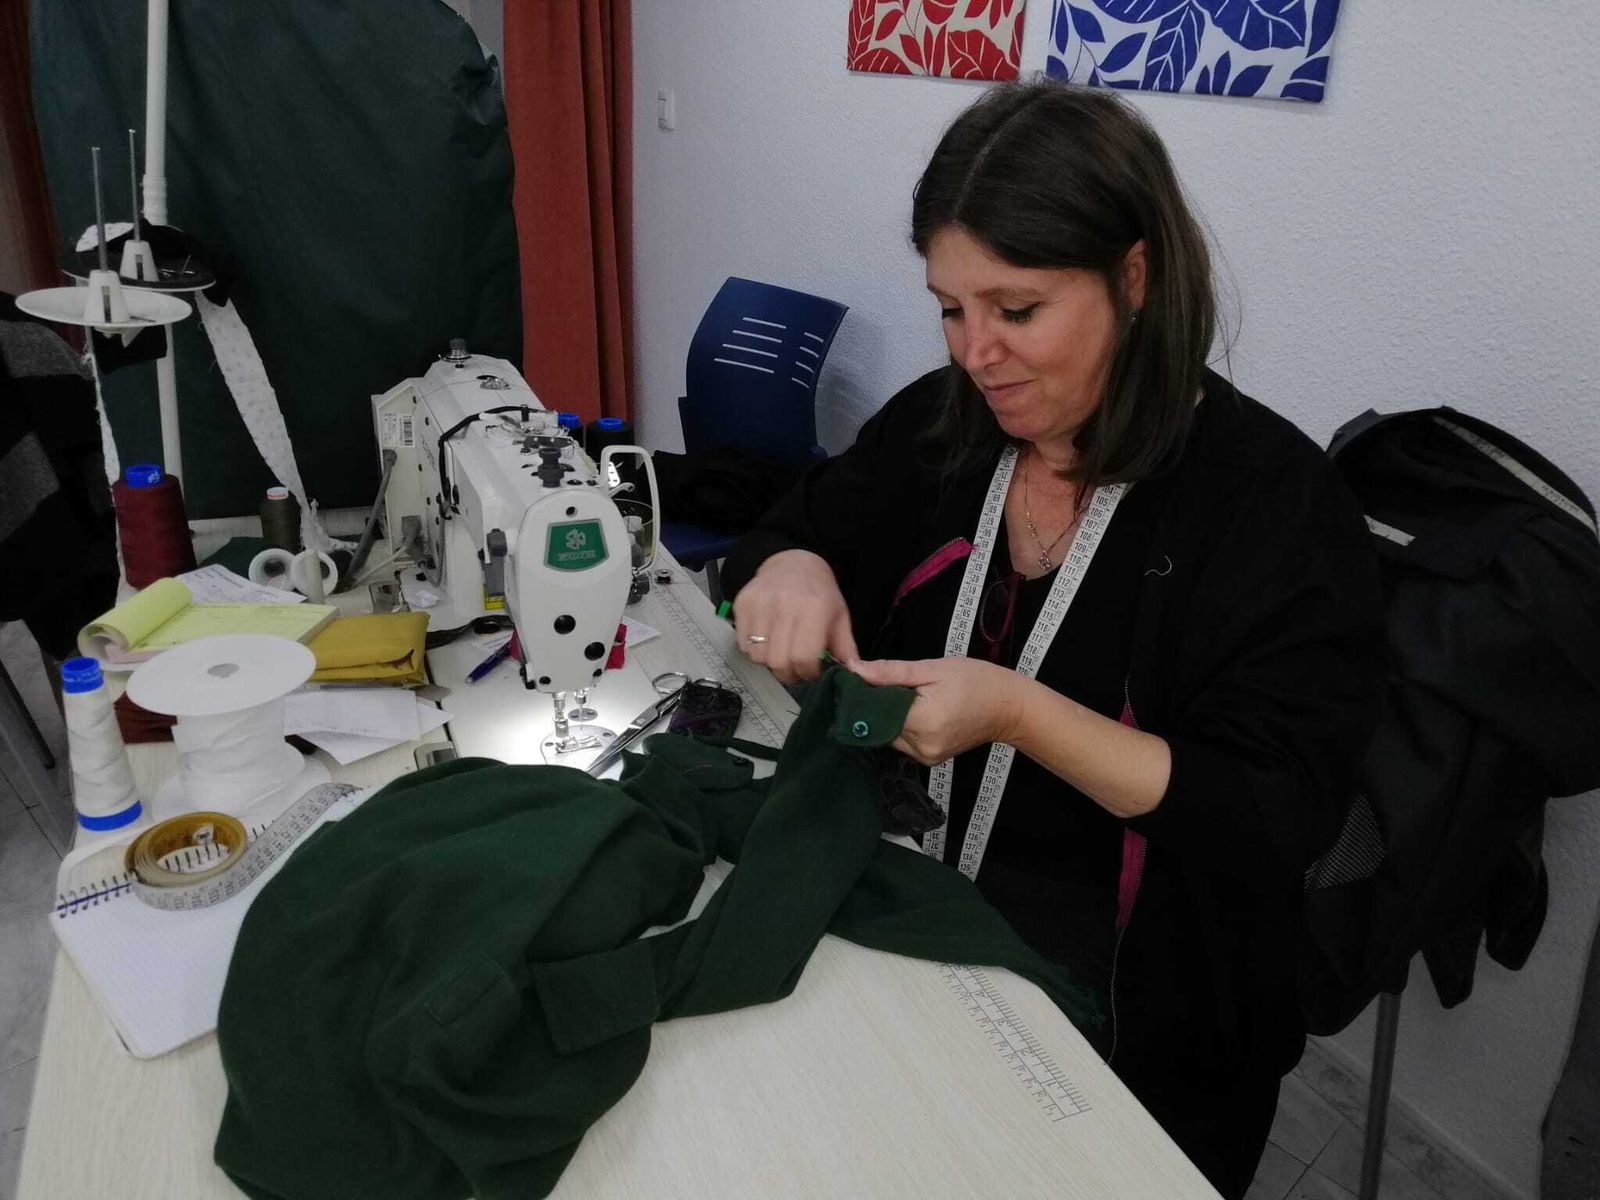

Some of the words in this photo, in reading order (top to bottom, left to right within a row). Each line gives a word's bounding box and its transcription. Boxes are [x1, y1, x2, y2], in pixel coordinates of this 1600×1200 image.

[1102, 485, 1113, 494] 104
[1097, 496, 1107, 506] 105
[1090, 507, 1102, 518] 106
[1085, 518, 1097, 529] 107
[1080, 530, 1092, 541] 108
[1075, 542, 1087, 553] 109
[1069, 553, 1081, 563] 110
[975, 563, 982, 571] 63
[1064, 565, 1075, 575] 111
[971, 575, 979, 583] 62
[1058, 576, 1070, 587] 112
[968, 586, 976, 594] 61
[1052, 588, 1065, 598] 113
[965, 598, 973, 606] 60
[1048, 600, 1059, 610] 114
[962, 609, 970, 617] 59
[1042, 610, 1054, 621] 115
[959, 621, 968, 629] 58
[1037, 621, 1048, 632] 116
[957, 632, 965, 640] 57
[1032, 633, 1043, 643] 117
[1027, 644, 1038, 654] 118
[1022, 655, 1032, 665] 119
[994, 744, 1005, 753] 127
[991, 754, 1002, 763] 128
[988, 765, 999, 774] 129
[985, 776, 996, 784] 130
[982, 786, 992, 794] 131
[980, 796, 990, 804] 132
[968, 833, 978, 841] 136
